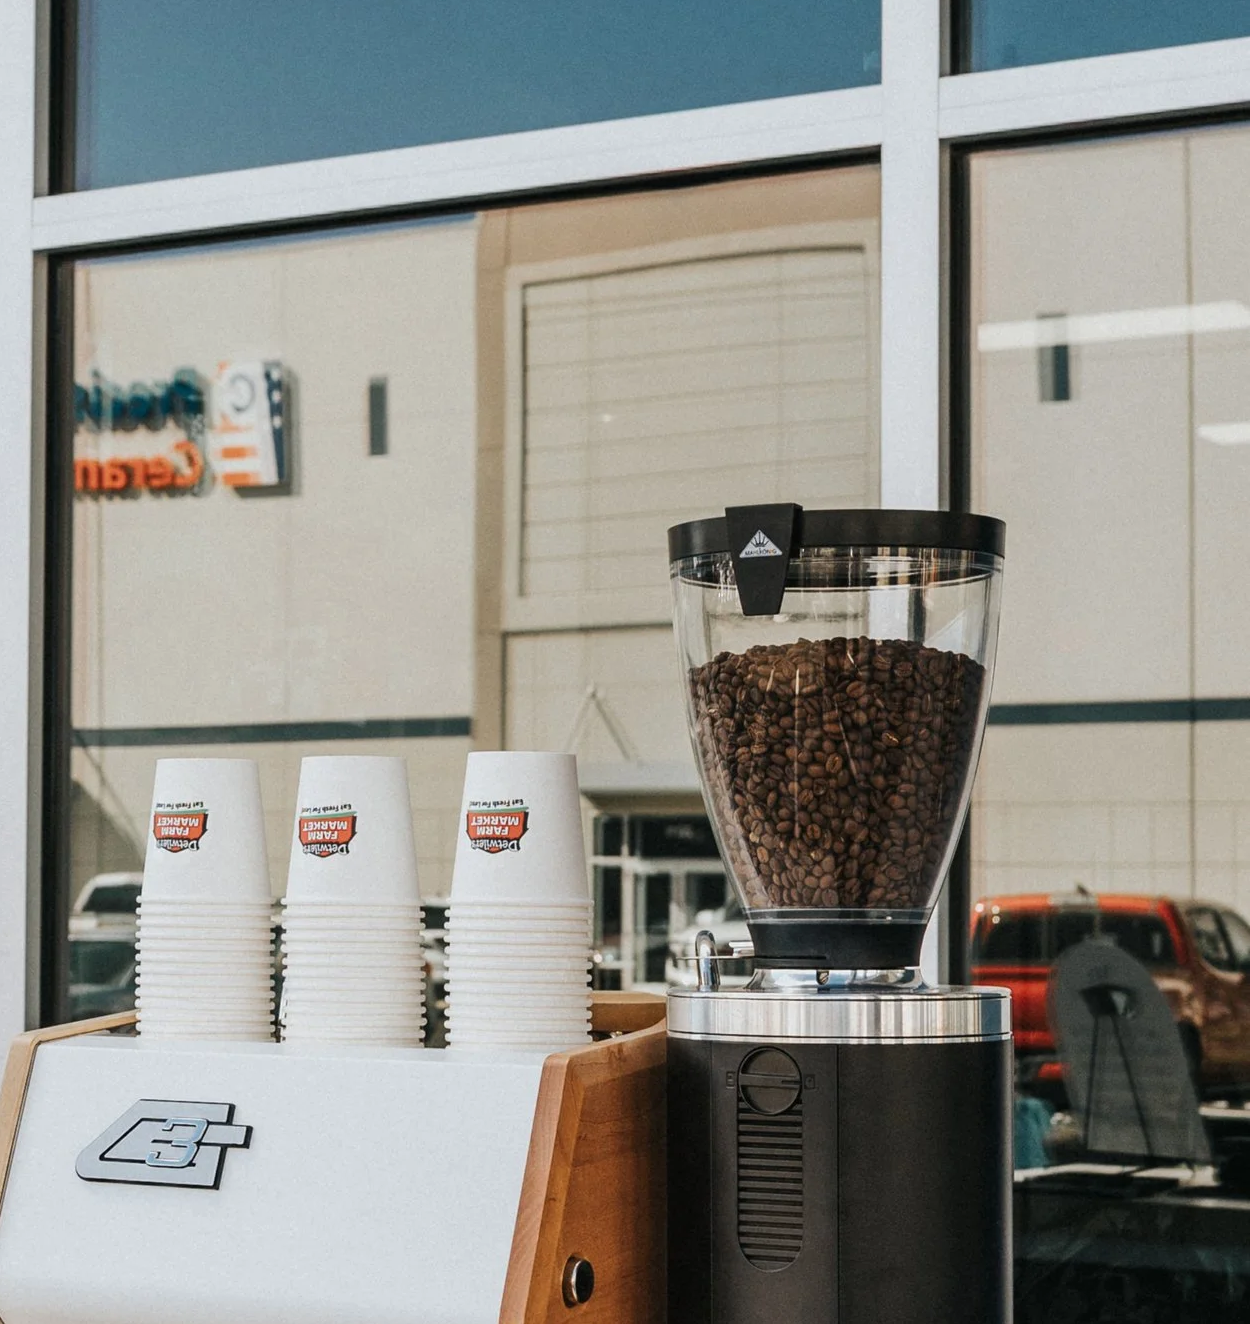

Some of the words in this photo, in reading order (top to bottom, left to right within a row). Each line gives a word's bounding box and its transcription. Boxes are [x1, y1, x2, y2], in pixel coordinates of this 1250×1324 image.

[493, 800, 511, 808] Fresh
[157, 817, 199, 826] MARKET
[471, 816, 519, 826] MARKET
[302, 821, 347, 831] MARKET
[476, 826, 509, 835] FARM
[161, 827, 189, 836] FARM
[307, 831, 338, 840] FARM
